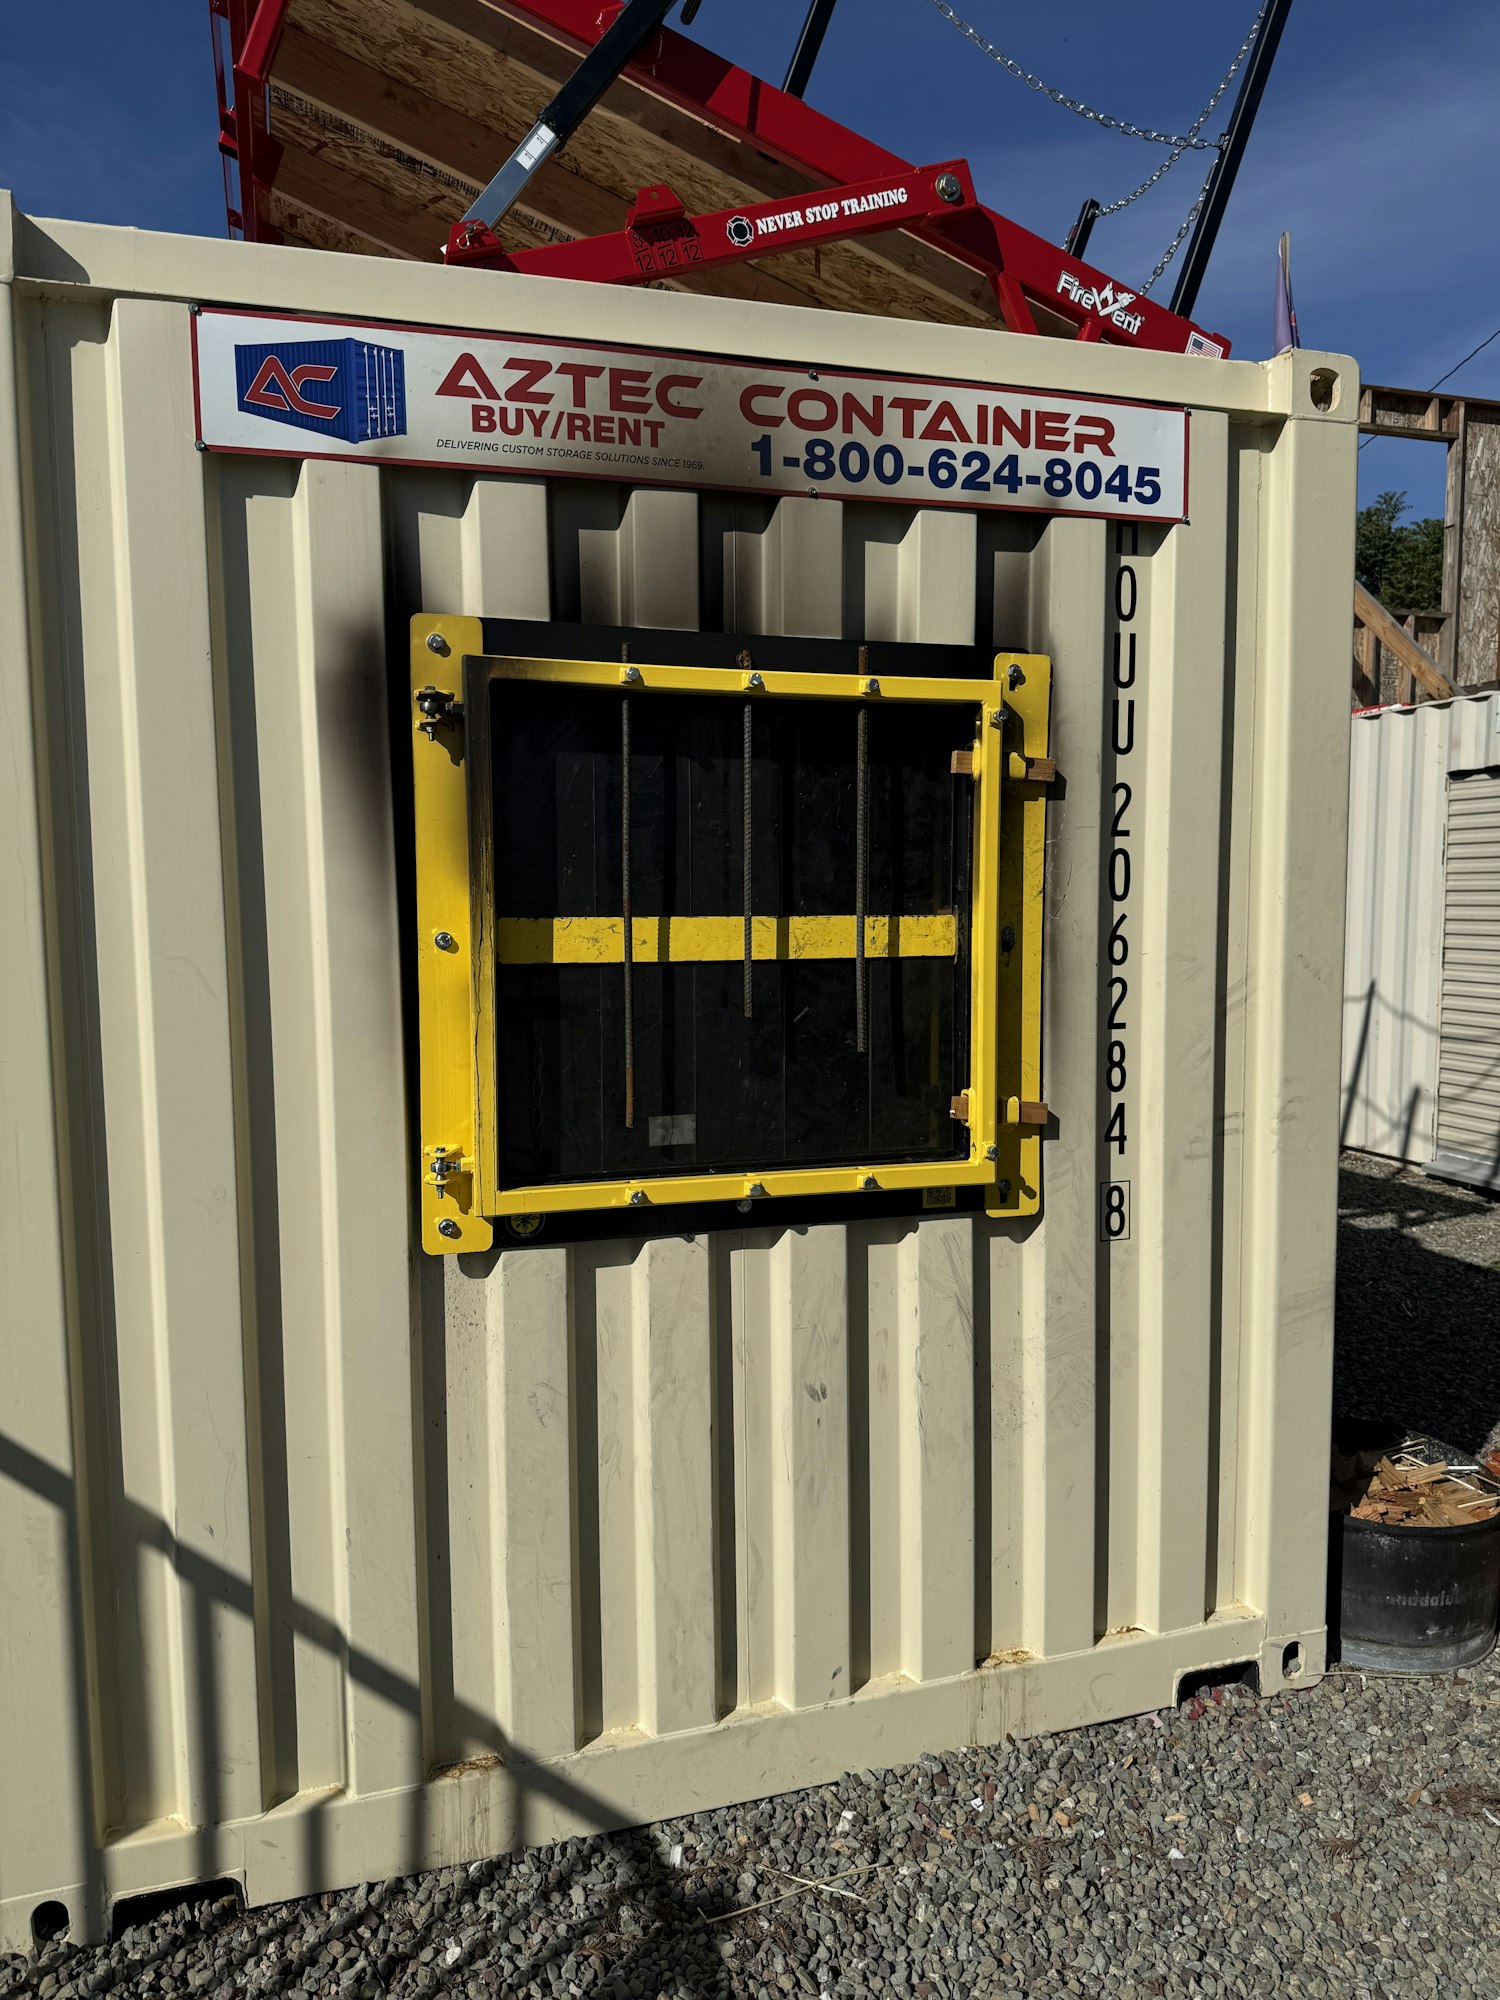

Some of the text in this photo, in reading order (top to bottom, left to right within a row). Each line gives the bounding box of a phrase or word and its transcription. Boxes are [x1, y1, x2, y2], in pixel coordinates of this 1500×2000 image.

[677, 221, 694, 238] 12
[756, 187, 908, 236] NEVER STOP TRAINING
[635, 243, 703, 272] 12 12 12
[435, 352, 1117, 457] AZTEC CONTAINER
[471, 404, 665, 447] BUY/RENT
[436, 438, 706, 471] DELIVERING CUSTOM STORAGE SOLUTIONS SINCE 1969.
[751, 434, 1162, 505] 1-800-624-8045
[1105, 782, 1132, 1155] 206284
[1105, 1184, 1127, 1238] 8
